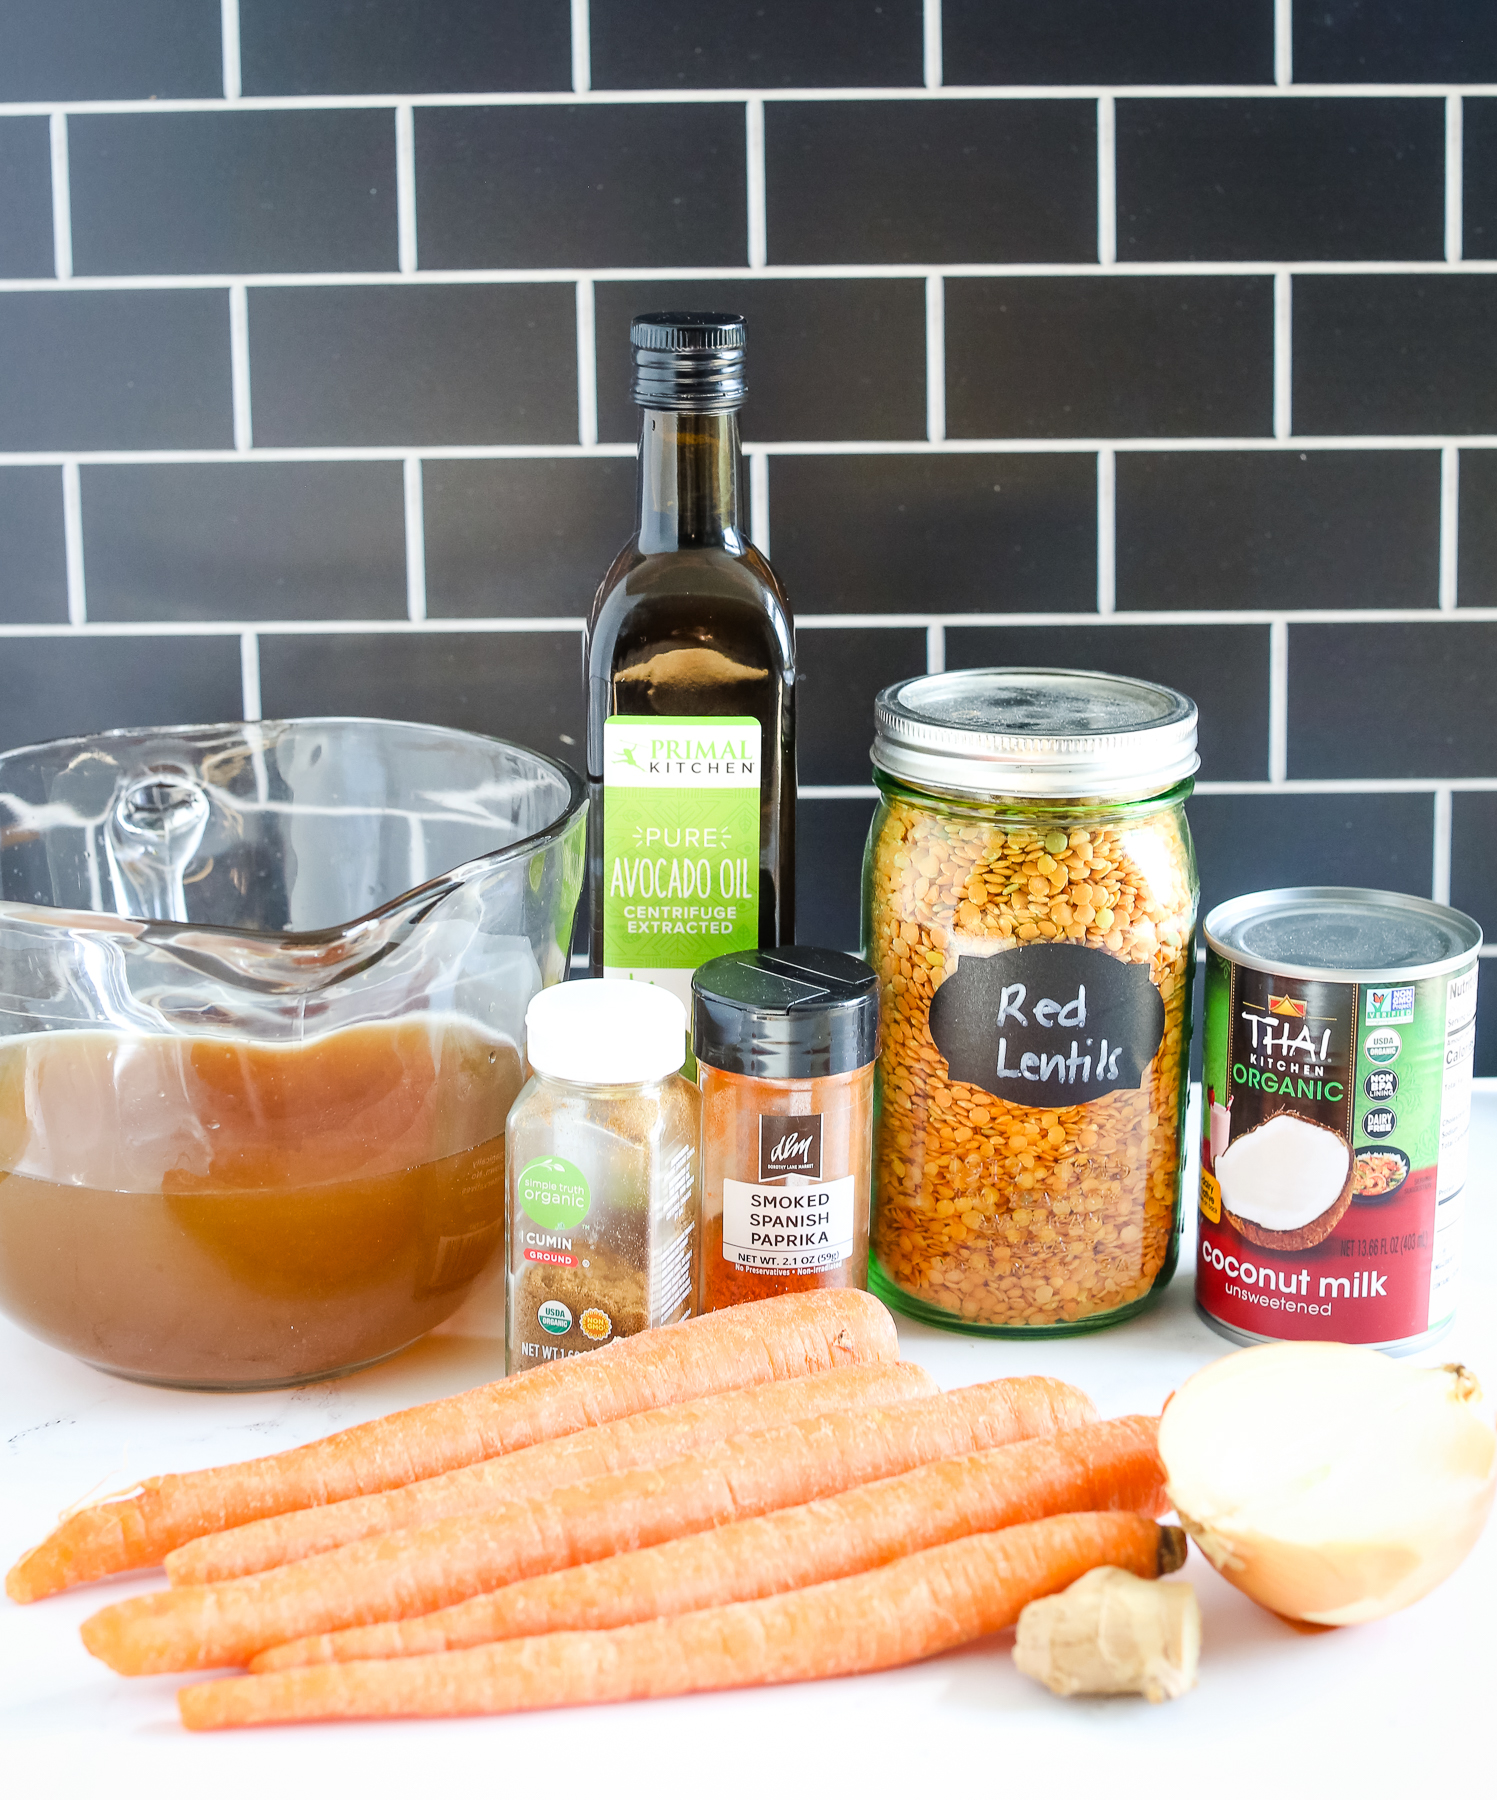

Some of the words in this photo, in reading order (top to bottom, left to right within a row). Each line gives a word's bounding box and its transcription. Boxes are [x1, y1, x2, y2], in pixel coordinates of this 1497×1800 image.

[650, 739, 753, 761] PRIMAL
[649, 761, 754, 774] KITCHEN
[646, 827, 718, 848] PURE
[610, 856, 712, 899] AVOCADO
[719, 858, 752, 899] OIL
[623, 905, 737, 919] CENTRIFUGE
[627, 920, 733, 934] EXTRACTED
[1393, 988, 1413, 998] NON
[996, 982, 1087, 1028] Red
[1369, 1010, 1412, 1019] VERIFIED
[1241, 1011, 1331, 1062] THAI
[1373, 1037, 1394, 1046] USDA
[1369, 1047, 1396, 1056] ORGANIC
[996, 1037, 1123, 1084] Lentils
[1249, 1053, 1324, 1077] KITCHEN
[1232, 1063, 1344, 1102] ORGANIC
[1370, 1074, 1394, 1083] NON
[1370, 1082, 1394, 1092] BPA
[1367, 1112, 1393, 1125] DAIRY
[1367, 1122, 1392, 1133] FREE
[524, 1178, 557, 1191] simple
[559, 1183, 585, 1195] truth
[524, 1189, 585, 1208] organic
[751, 1193, 830, 1209] SMOKED
[749, 1211, 829, 1228] SPANISH
[526, 1232, 572, 1251] CUMIN
[751, 1231, 829, 1247] PAPRIKA
[1340, 1239, 1355, 1257] NET
[1358, 1238, 1379, 1257] 13.66
[1380, 1237, 1388, 1255] FL
[1389, 1236, 1399, 1254] OZ
[1400, 1232, 1416, 1255] (403
[529, 1251, 572, 1264] GROUND
[738, 1252, 758, 1264] NET
[760, 1256, 780, 1266] WT.
[782, 1257, 797, 1266] 2.1
[801, 1255, 815, 1265] OZ
[817, 1250, 840, 1264] (59g)
[735, 1262, 744, 1272] No
[745, 1265, 790, 1276] Preservatives
[1202, 1240, 1310, 1296] coconut
[1319, 1270, 1388, 1298] milk
[1225, 1282, 1332, 1316] unsweetened
[545, 1307, 565, 1318] USDA
[542, 1317, 568, 1328] ORGANIC
[587, 1317, 604, 1326] NON
[587, 1323, 605, 1331] GMO
[521, 1341, 540, 1358] NET
[542, 1345, 558, 1361] WT
